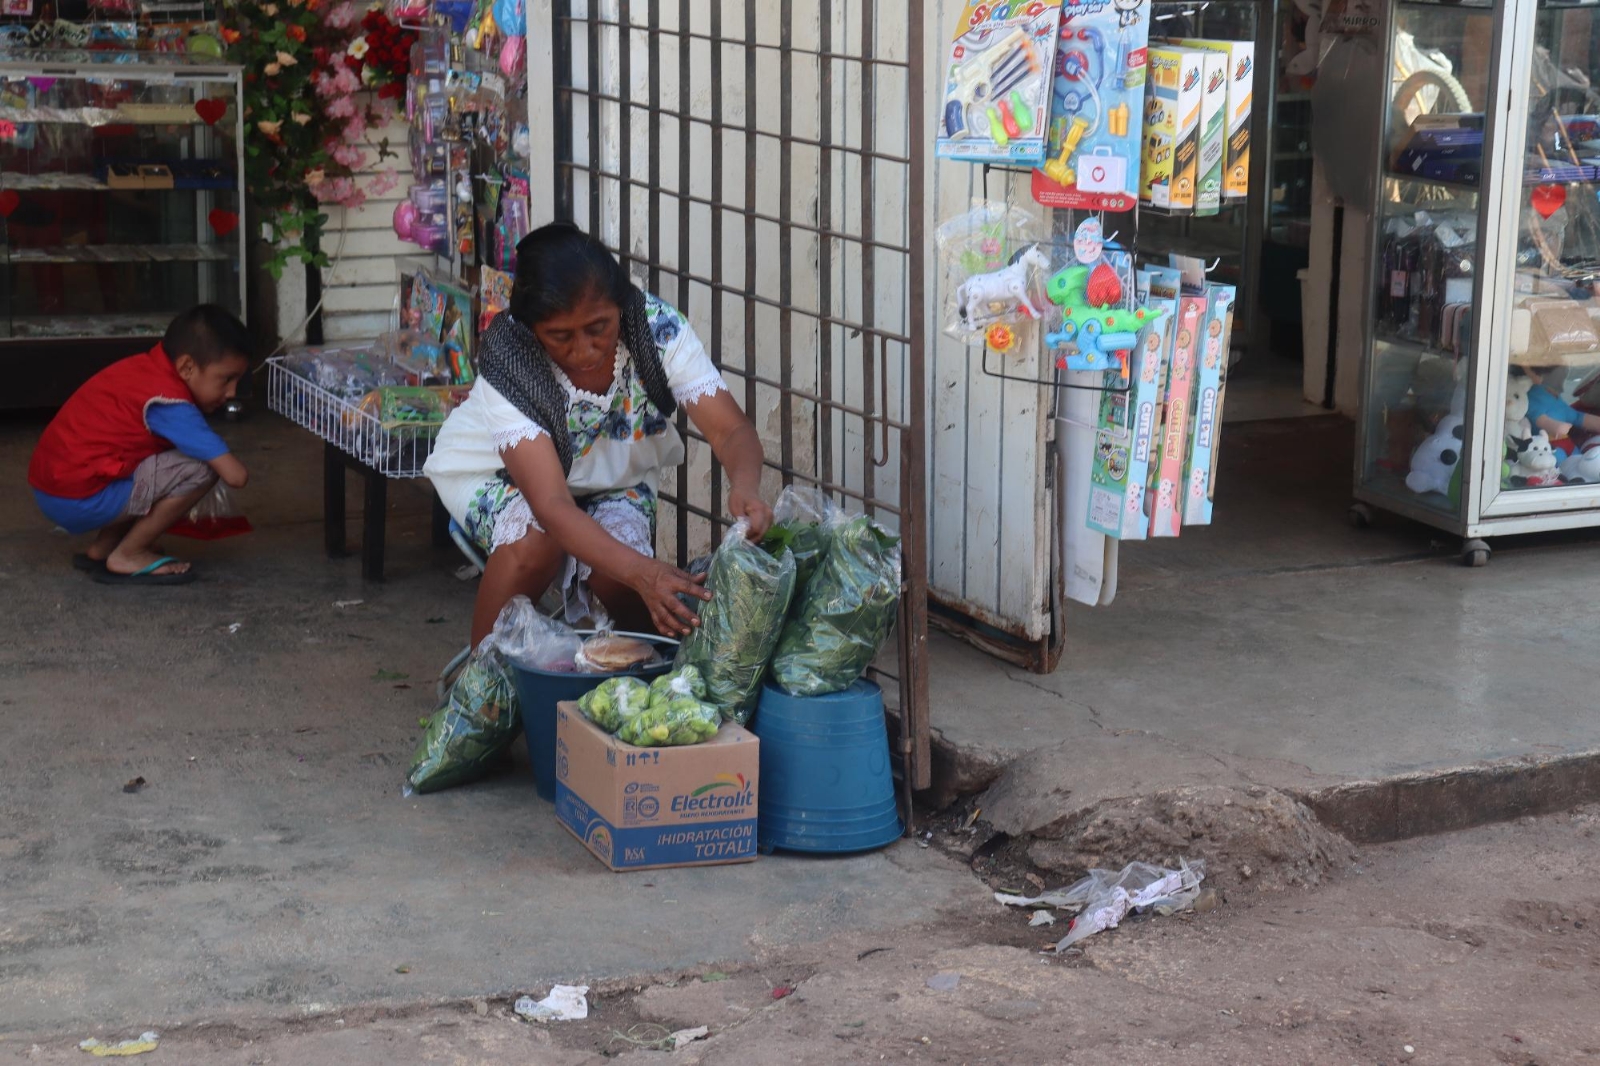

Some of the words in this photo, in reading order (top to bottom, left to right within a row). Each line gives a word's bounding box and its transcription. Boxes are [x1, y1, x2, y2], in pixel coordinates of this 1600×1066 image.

[1139, 401, 1153, 435] CUTE
[1170, 398, 1185, 432] CUTE
[1201, 387, 1215, 421] CUTE
[1200, 422, 1211, 448] PET
[1135, 437, 1148, 462] PET
[671, 781, 755, 812] Electrolit
[657, 824, 753, 846] ¡HIDRATACIÓN
[695, 838, 752, 858] TOTAL!
